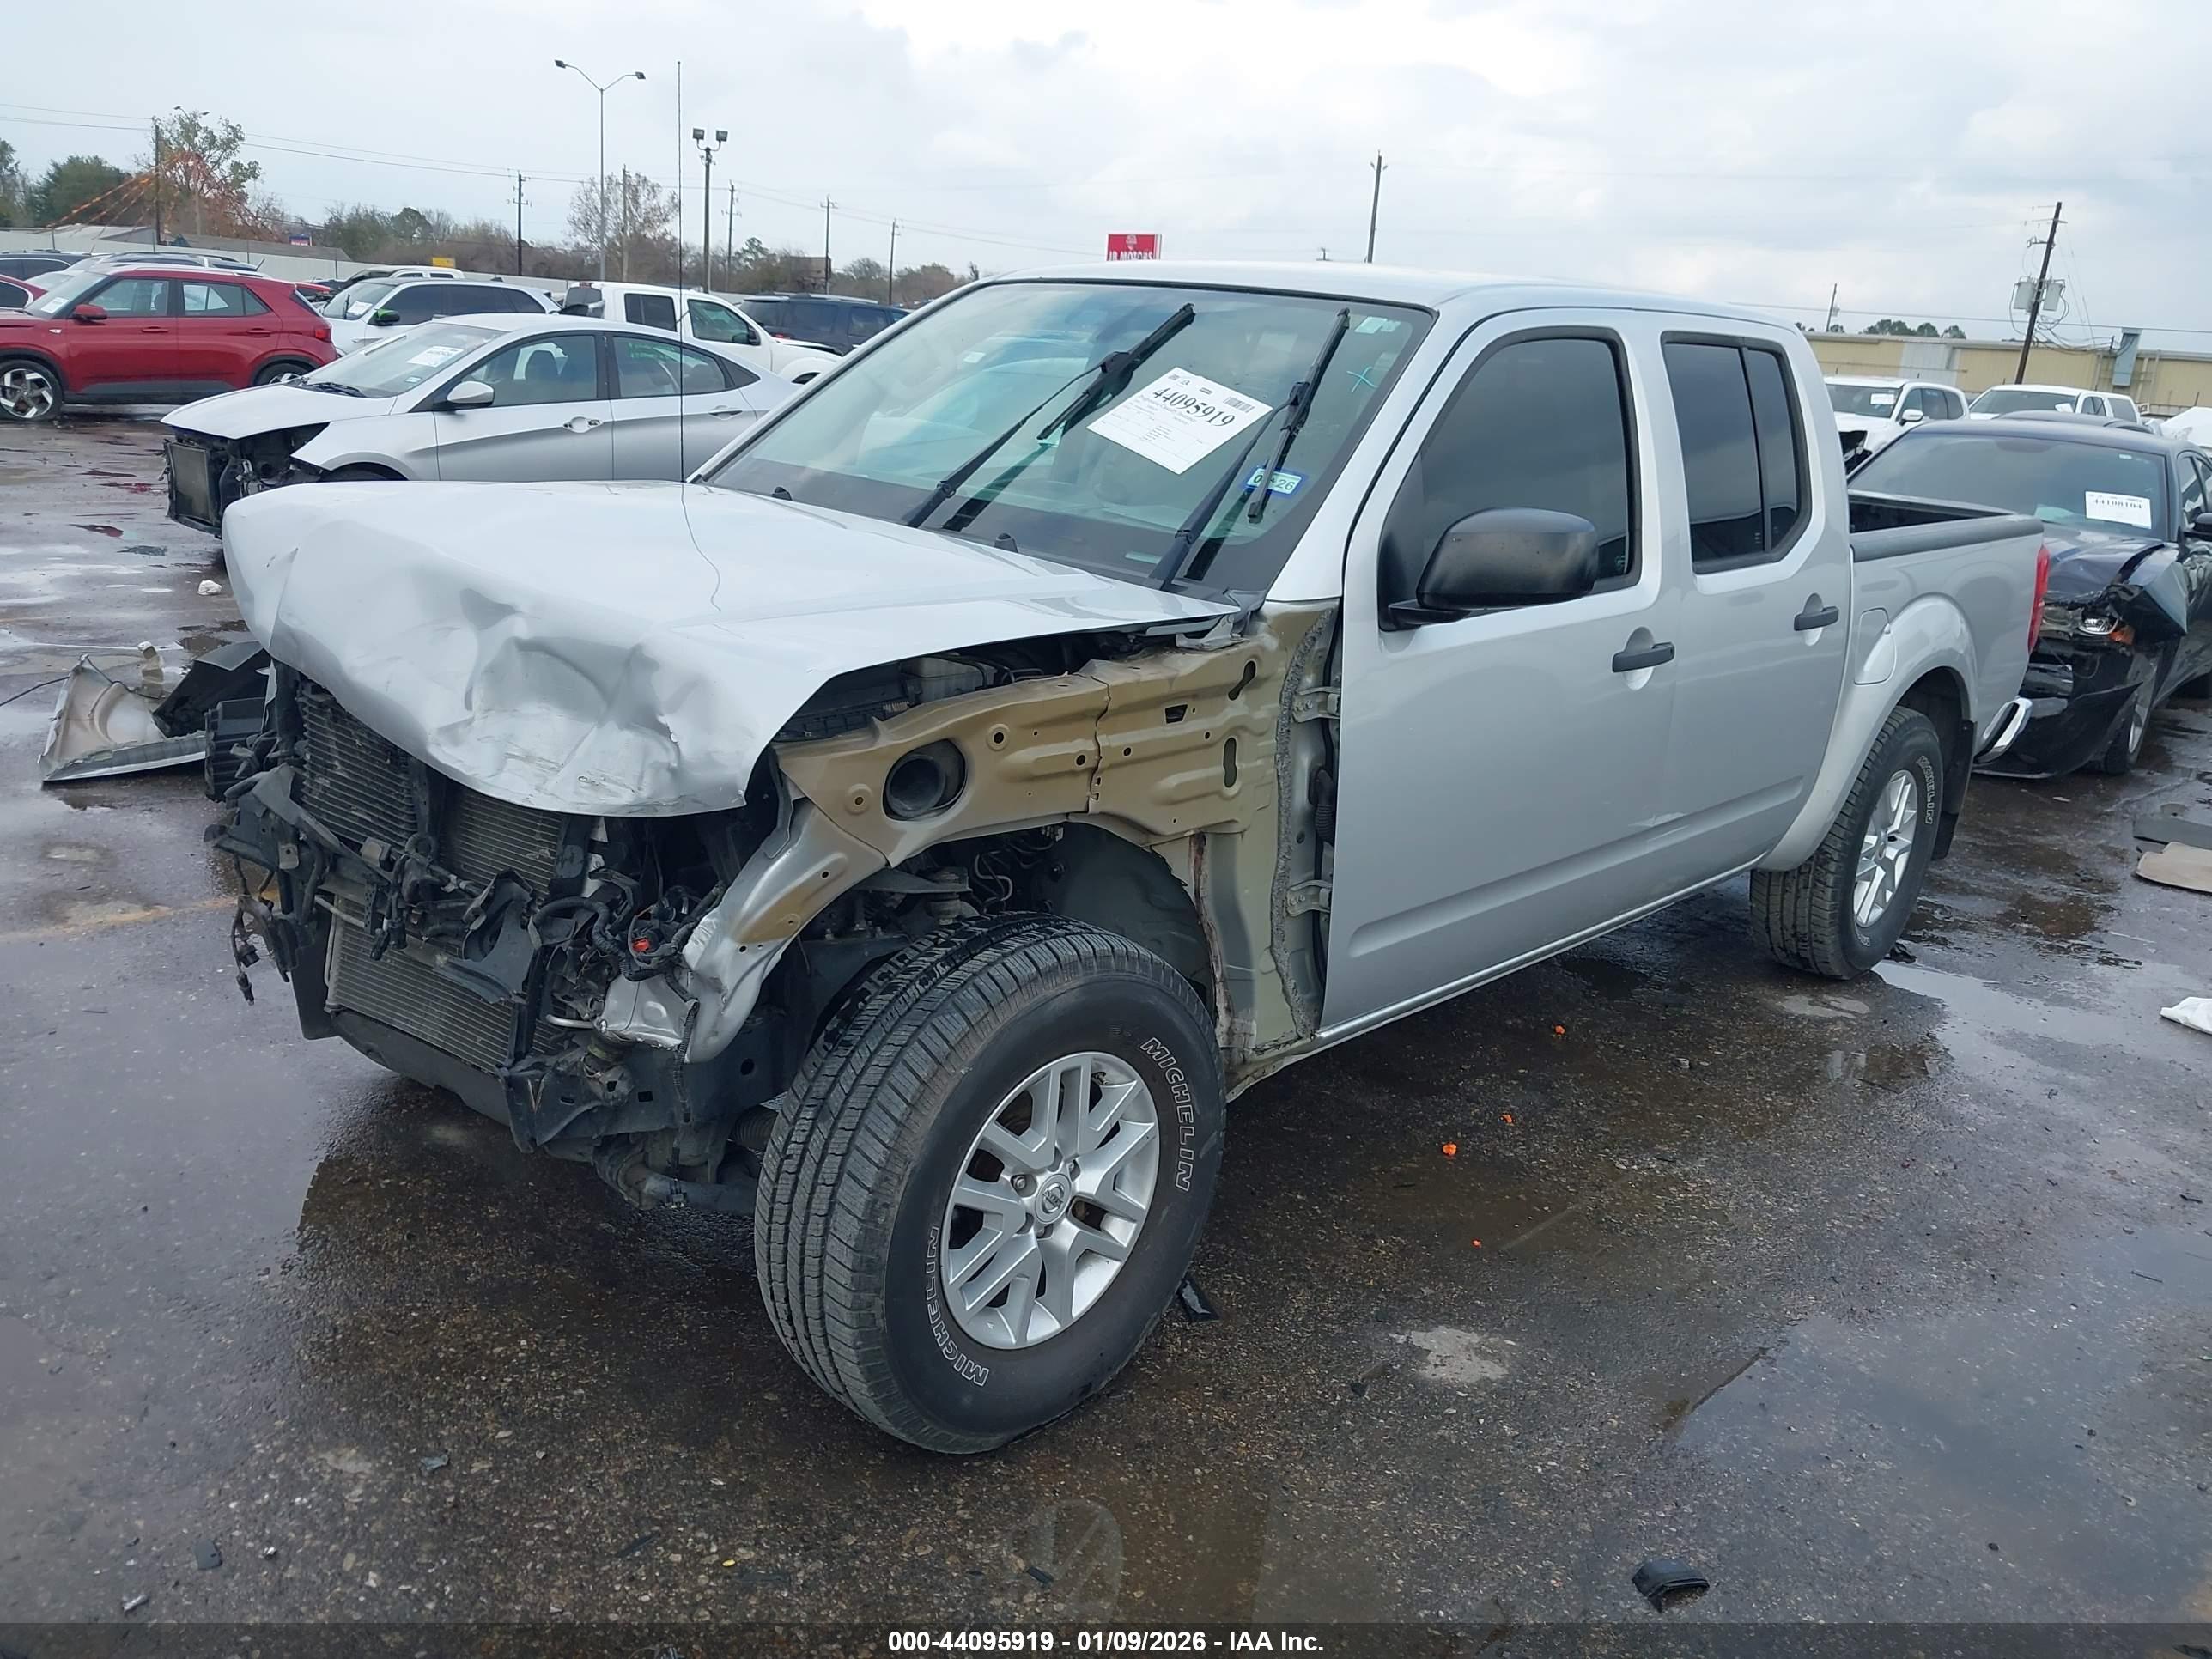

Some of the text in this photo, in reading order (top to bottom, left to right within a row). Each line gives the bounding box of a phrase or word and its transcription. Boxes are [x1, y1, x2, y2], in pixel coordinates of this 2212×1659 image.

[1153, 387, 1236, 427] 44095919
[1139, 1036, 1195, 1192] MICHELIN
[926, 1225, 990, 1387] MICHELIN
